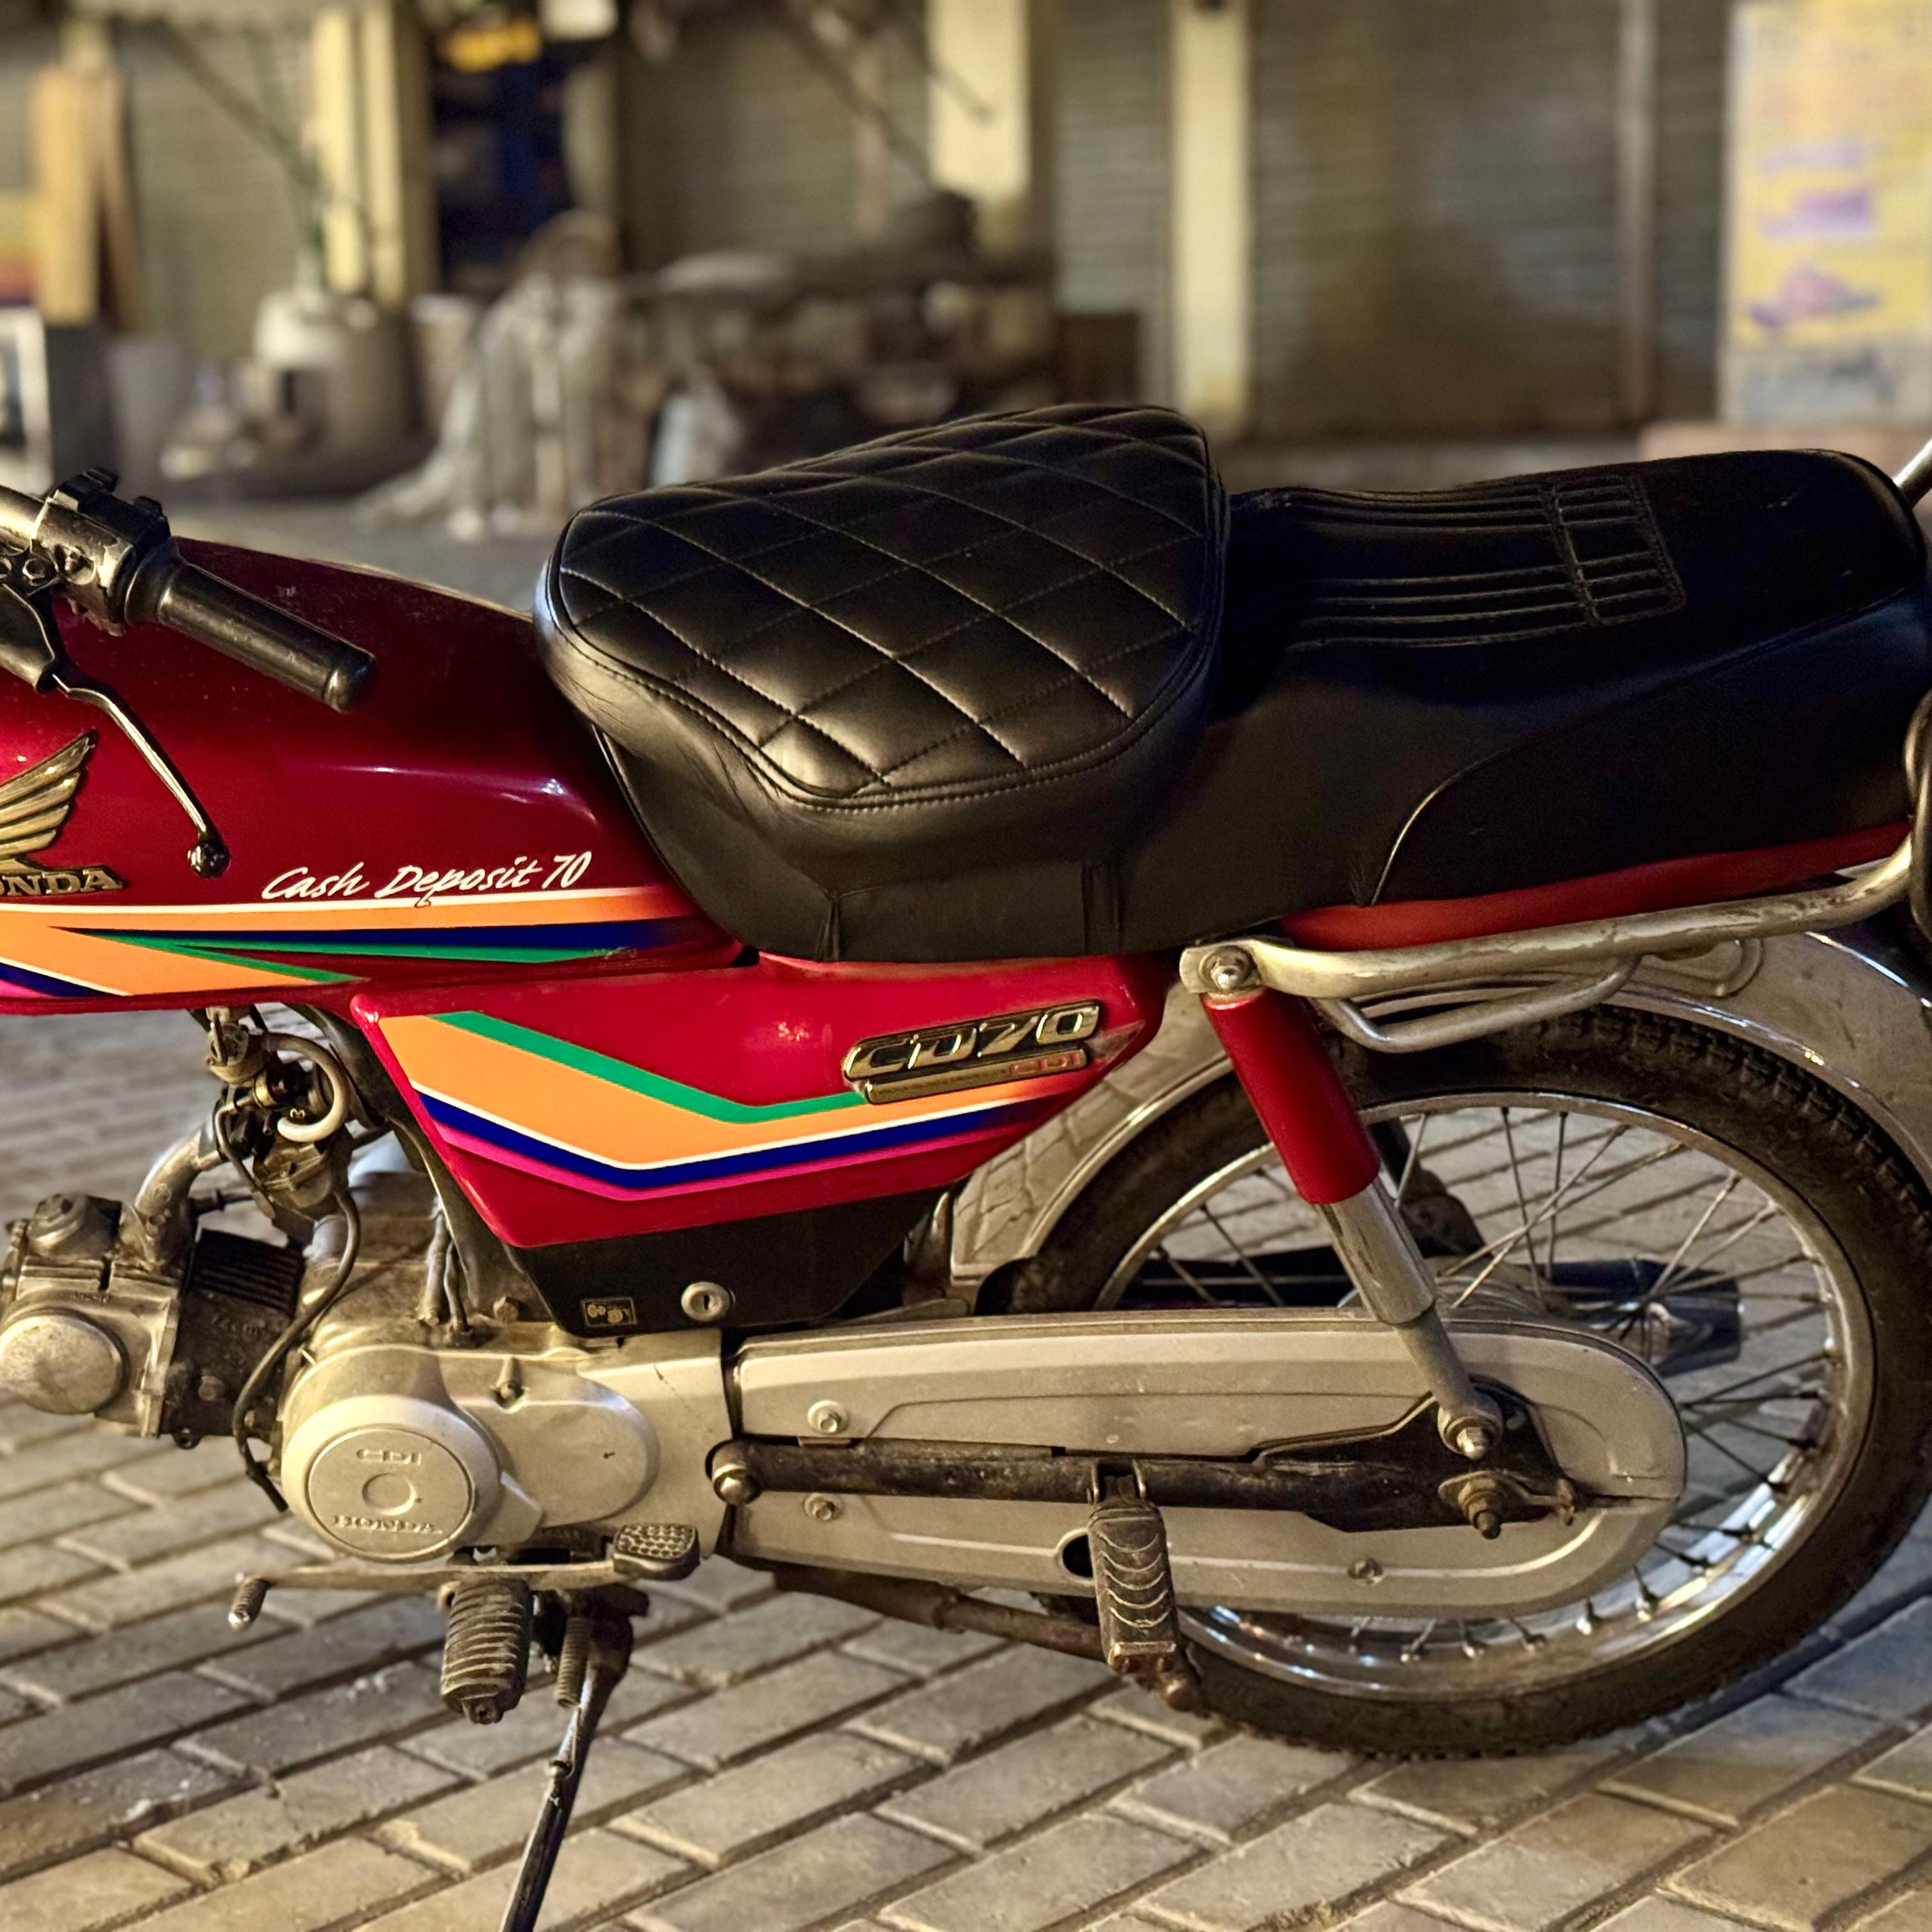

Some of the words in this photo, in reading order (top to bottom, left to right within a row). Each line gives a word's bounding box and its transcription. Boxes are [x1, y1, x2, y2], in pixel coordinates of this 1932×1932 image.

[0, 868, 123, 896] NDA
[261, 861, 369, 900] Cash
[374, 856, 543, 908] Deposit
[542, 850, 593, 889] 70
[845, 1005, 1100, 1078] CD70
[1009, 1048, 1082, 1075] CDI
[356, 1448, 422, 1466] CDI
[332, 1514, 443, 1535] HONDA
